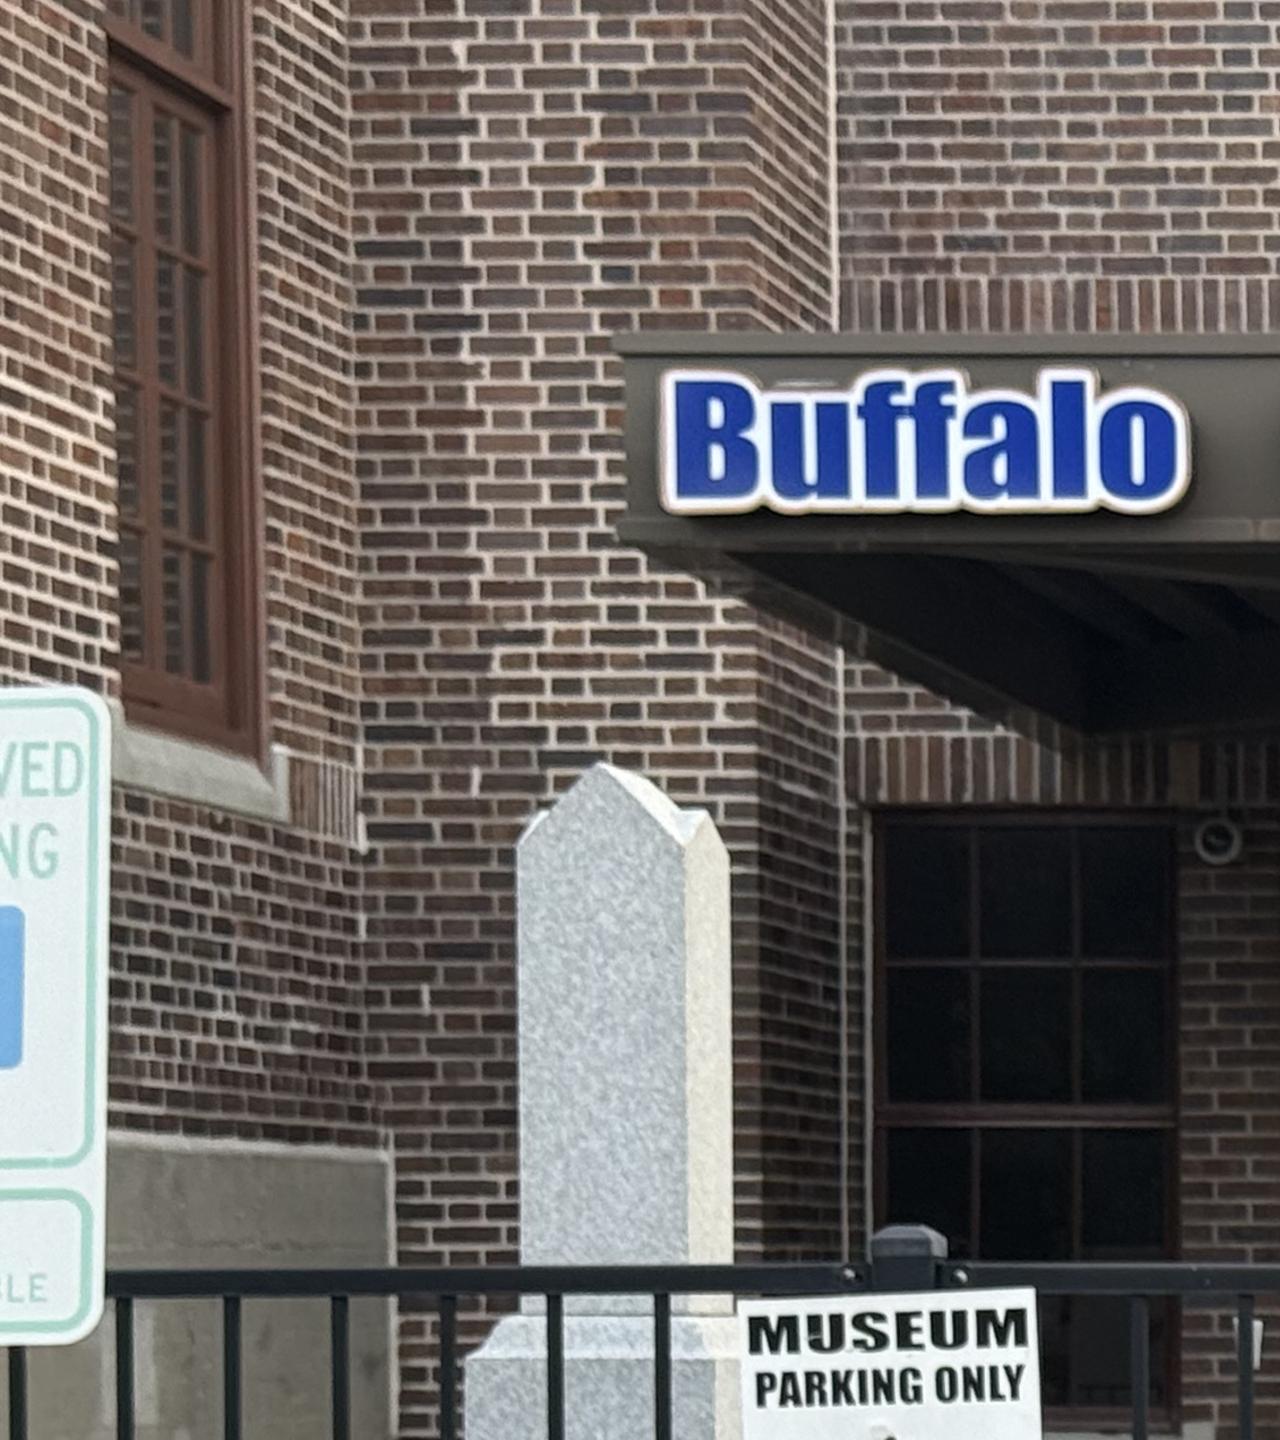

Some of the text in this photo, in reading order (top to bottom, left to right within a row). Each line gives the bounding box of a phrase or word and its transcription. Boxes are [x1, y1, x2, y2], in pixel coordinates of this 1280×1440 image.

[674, 379, 1178, 500] Buffalo
[0, 1273, 48, 1302] LE
[747, 1307, 1029, 1356] MUSEUM
[755, 1364, 1026, 1408] PARKING ONLY
